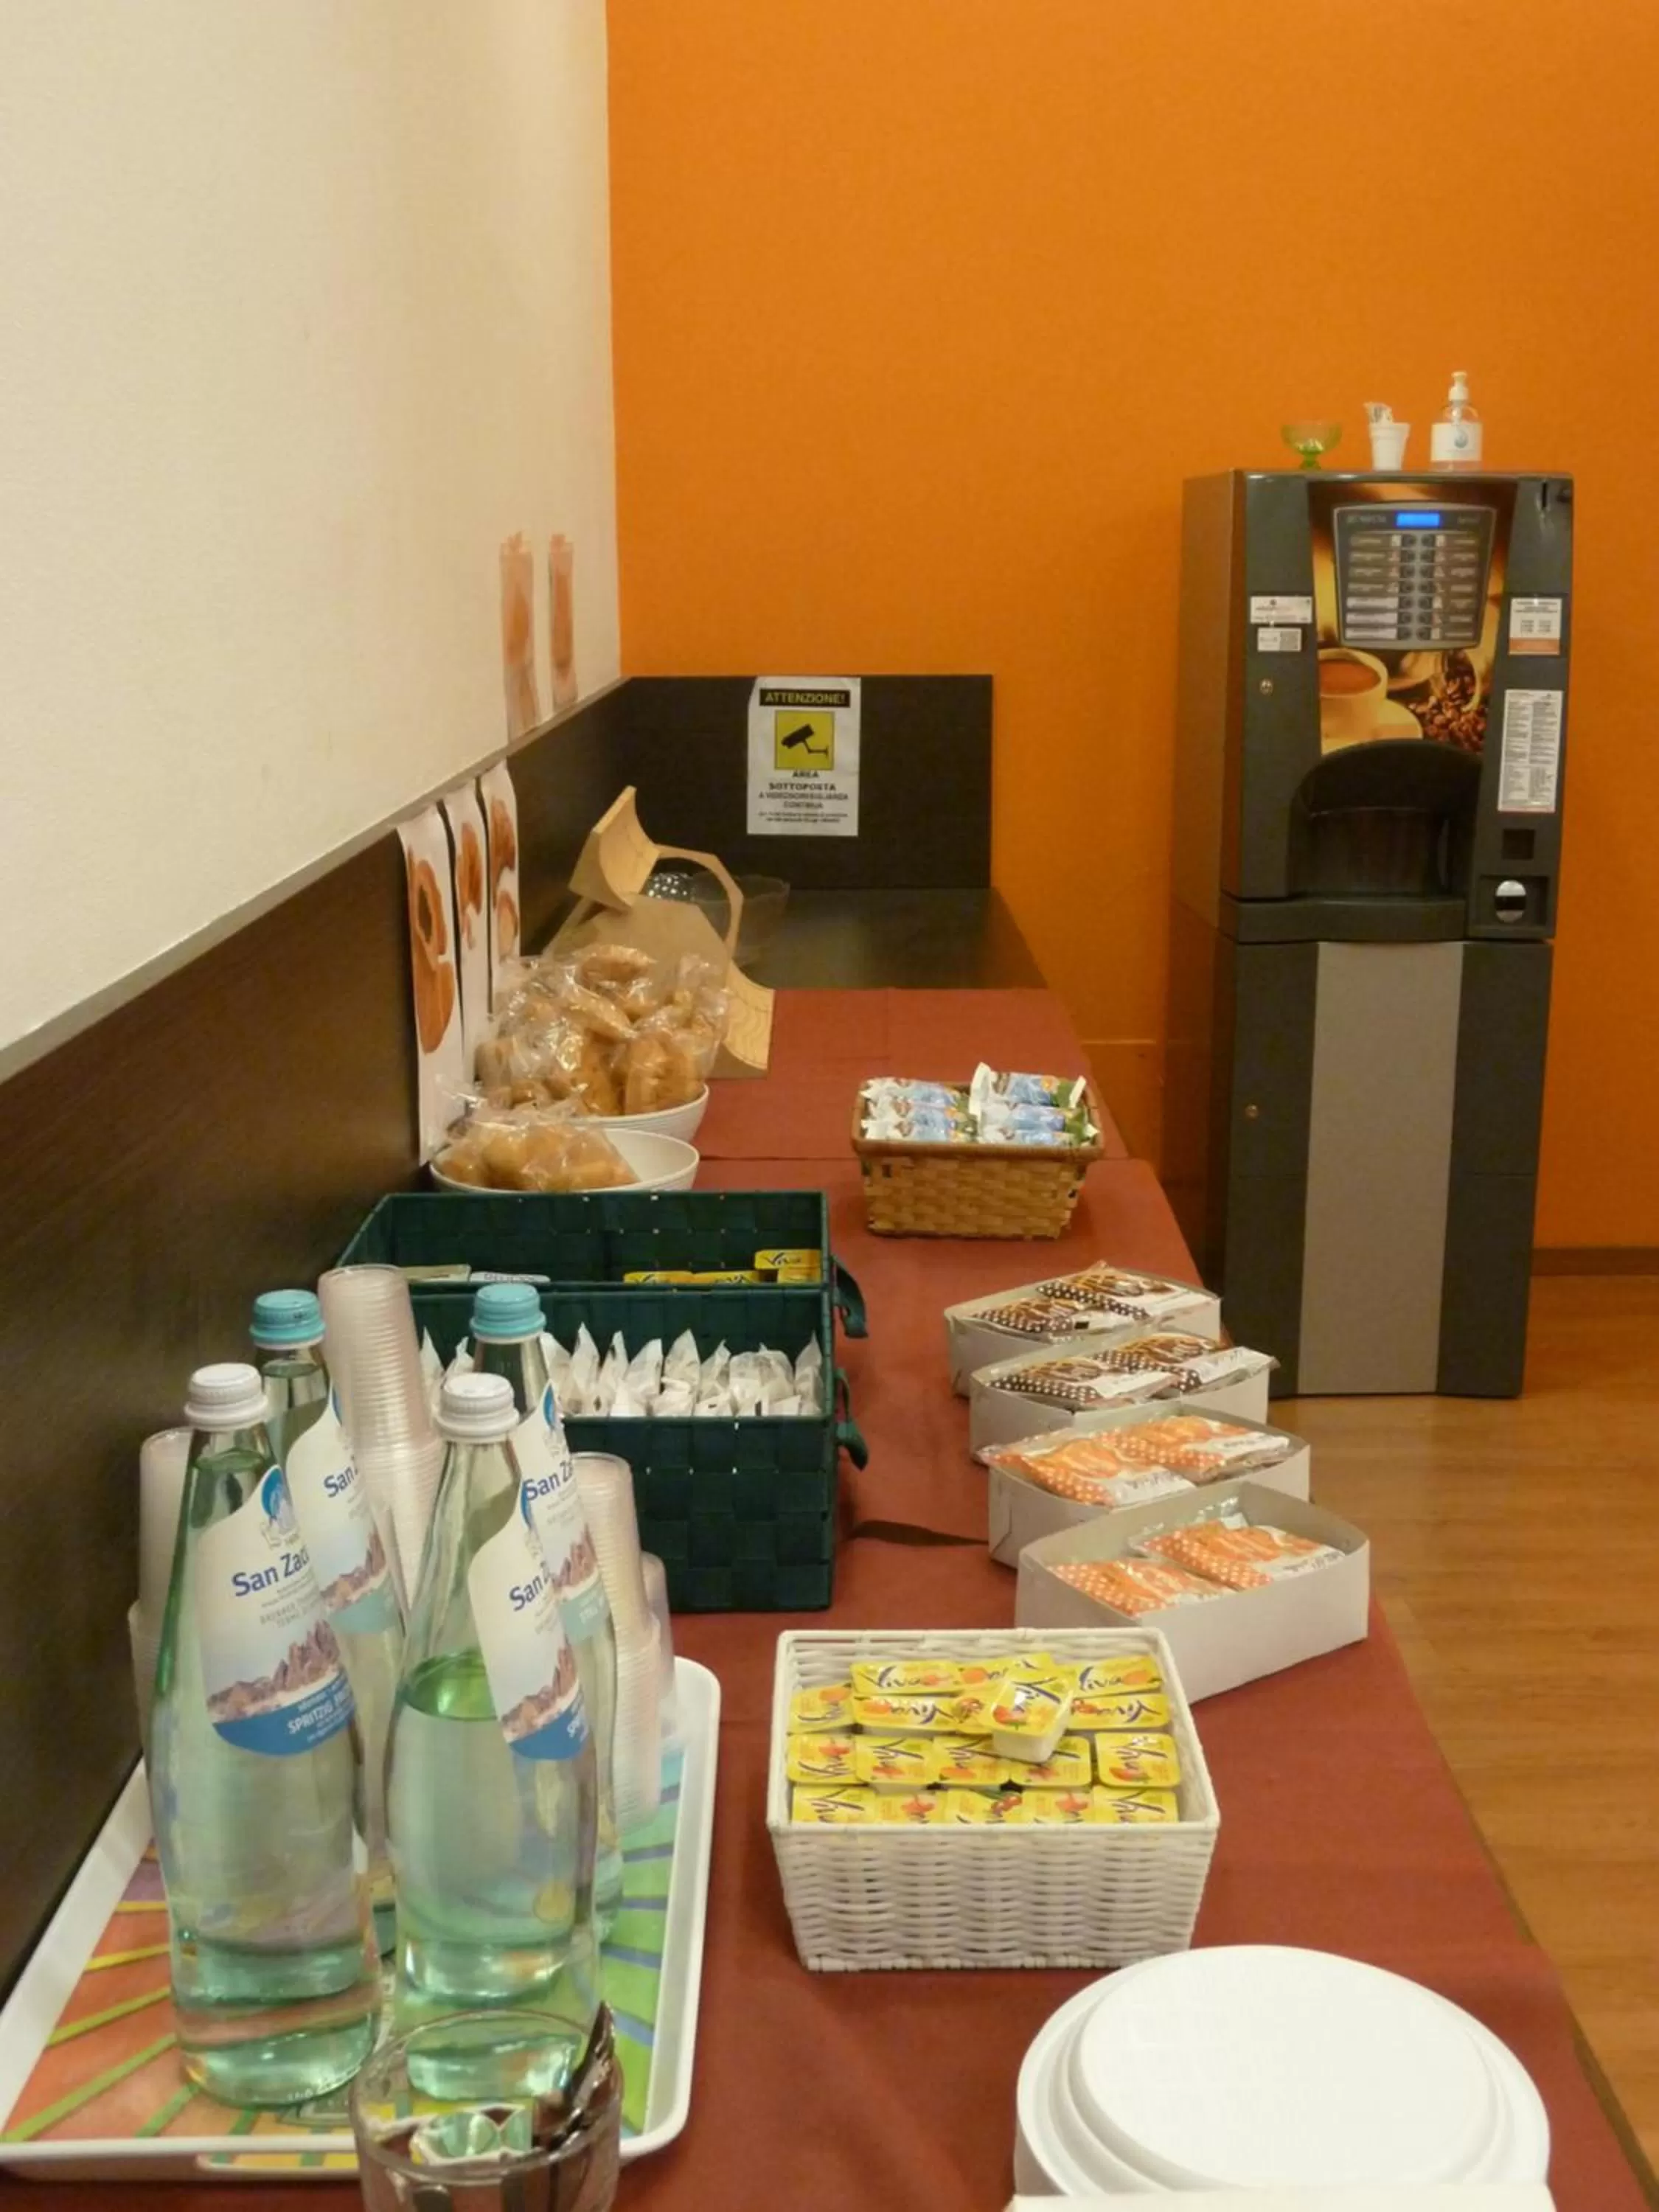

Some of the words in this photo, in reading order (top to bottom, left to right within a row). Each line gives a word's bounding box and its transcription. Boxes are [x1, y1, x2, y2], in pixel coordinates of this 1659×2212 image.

[768, 782, 836, 791] SOTTOPOSTA
[792, 771, 819, 779] AREA
[324, 1466, 355, 1498] San
[523, 1471, 561, 1501] San
[231, 1567, 279, 1597] San
[509, 1575, 543, 1612] San
